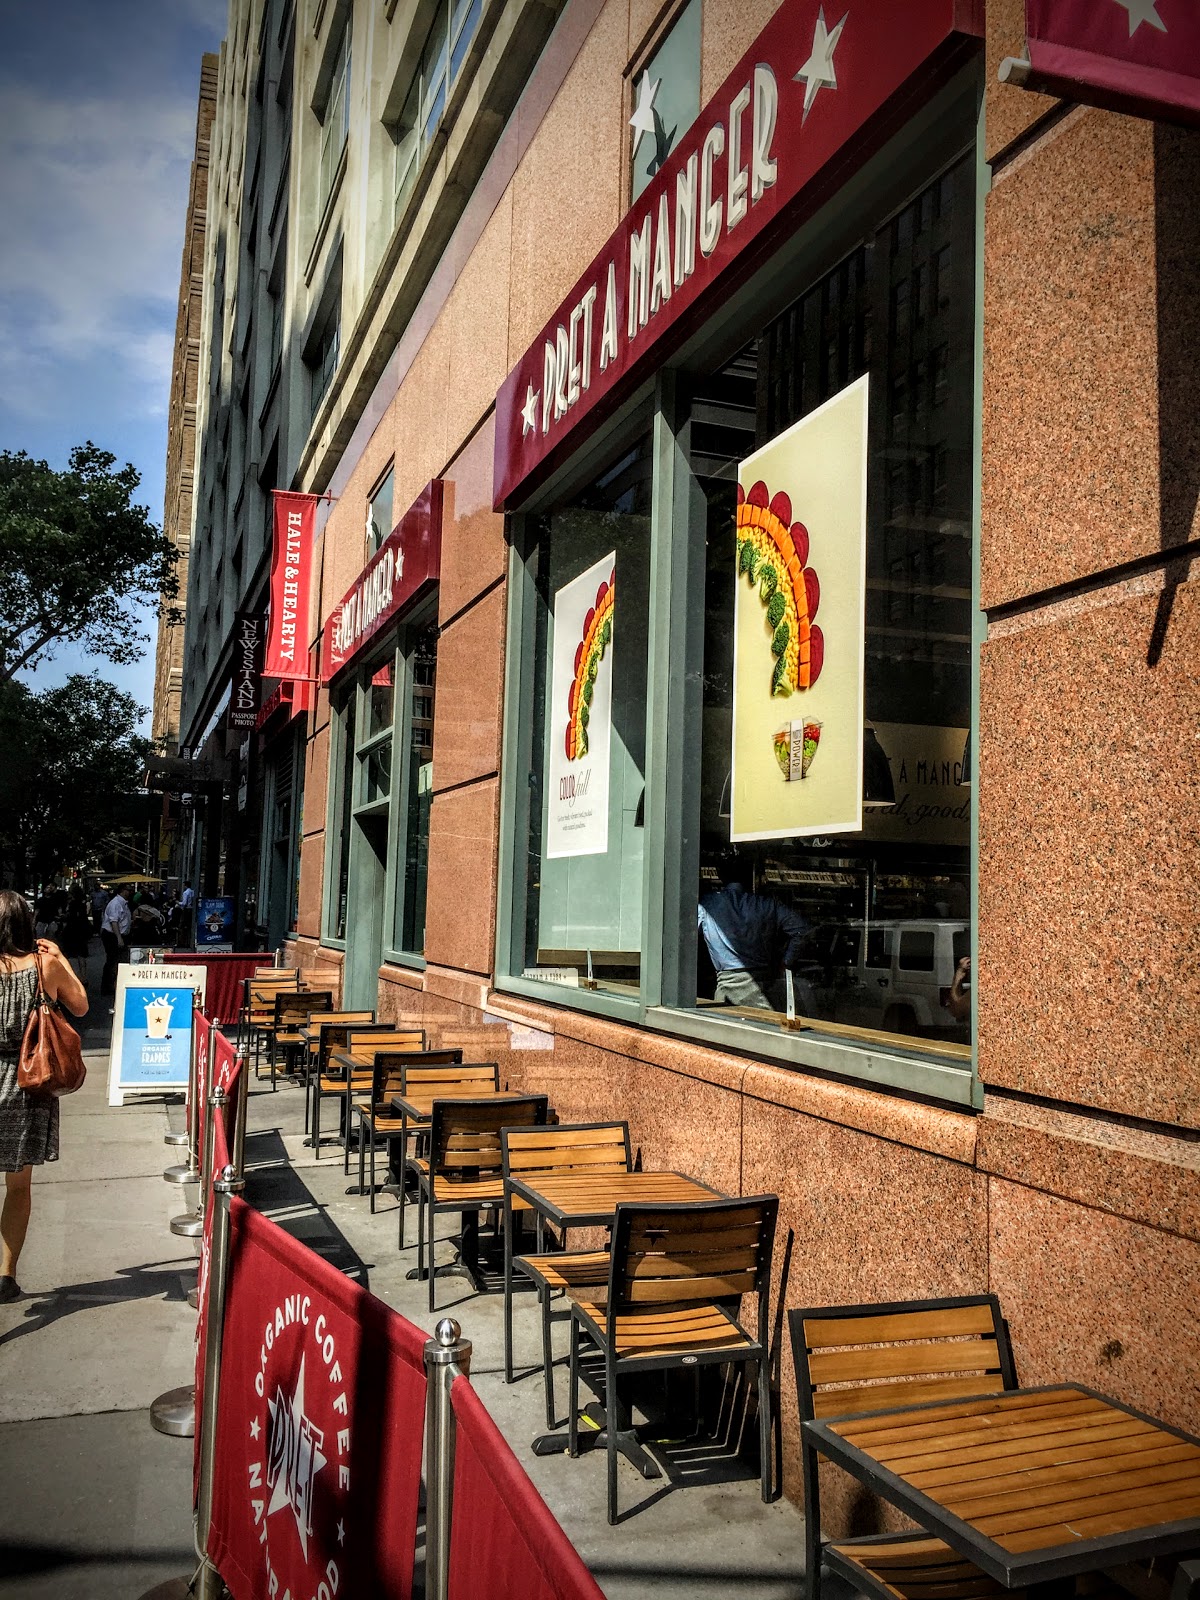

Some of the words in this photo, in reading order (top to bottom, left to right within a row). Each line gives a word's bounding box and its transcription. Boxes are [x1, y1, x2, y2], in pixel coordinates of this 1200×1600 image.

[542, 282, 597, 437] PRET
[600, 258, 618, 374] A
[628, 62, 778, 343] MANGER
[362, 546, 394, 633] MANGER
[237, 619, 260, 709] NEWSSTAND
[231, 711, 258, 720] PASSPORT
[234, 719, 255, 727] PHOTO
[792, 739, 801, 768] POWER
[899, 758, 908, 783] A
[137, 970, 152, 980] PRET
[155, 971, 159, 980] A
[161, 970, 188, 980] MANGER
[141, 1052, 171, 1063] FRAPPES
[255, 1294, 311, 1398] ORGANIC
[315, 1314, 350, 1492] COFFEE
